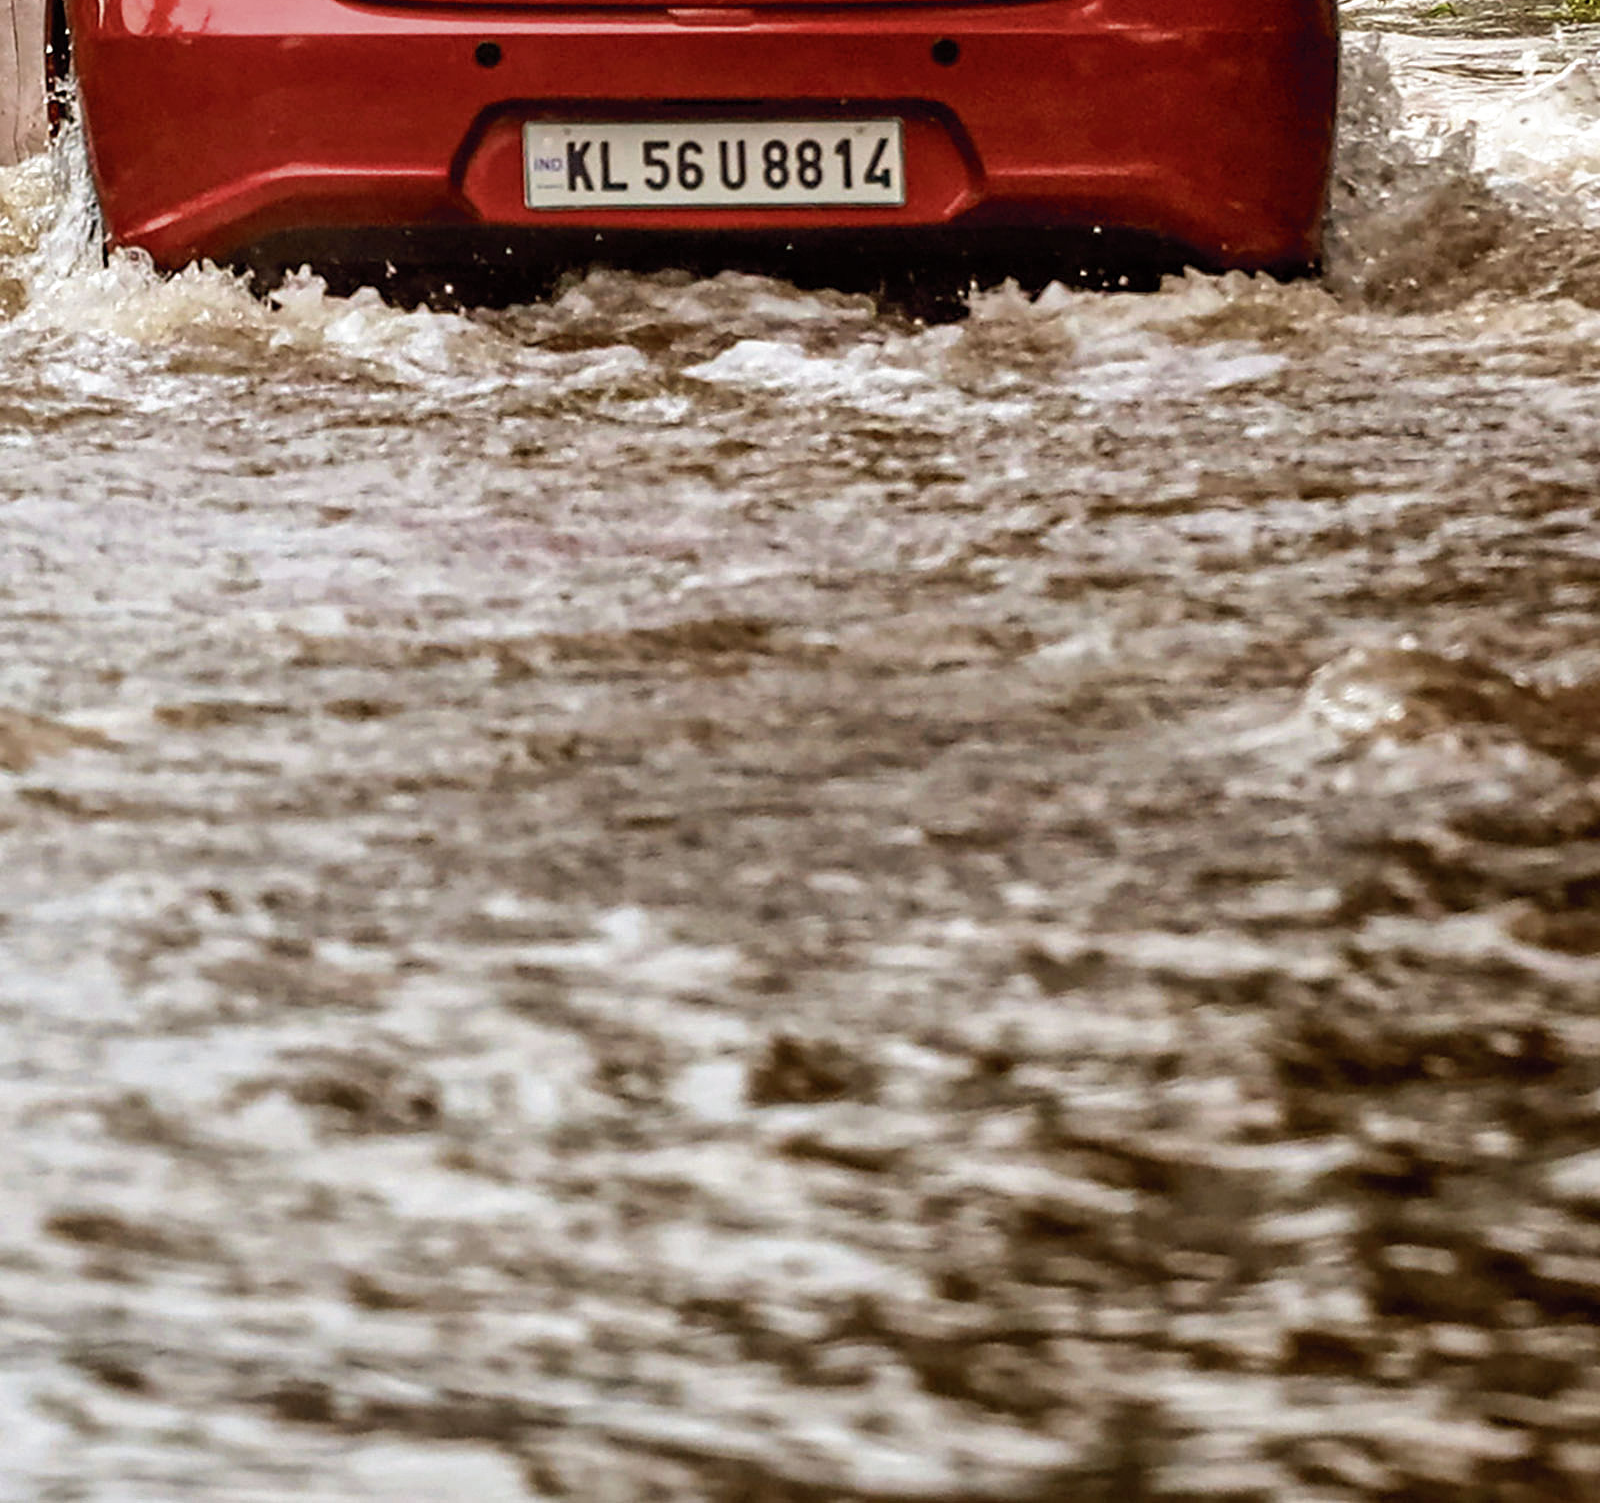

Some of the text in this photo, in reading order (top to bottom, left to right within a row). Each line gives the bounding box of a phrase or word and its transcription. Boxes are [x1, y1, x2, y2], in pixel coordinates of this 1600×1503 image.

[566, 138, 892, 192] KL 56 U 8814
